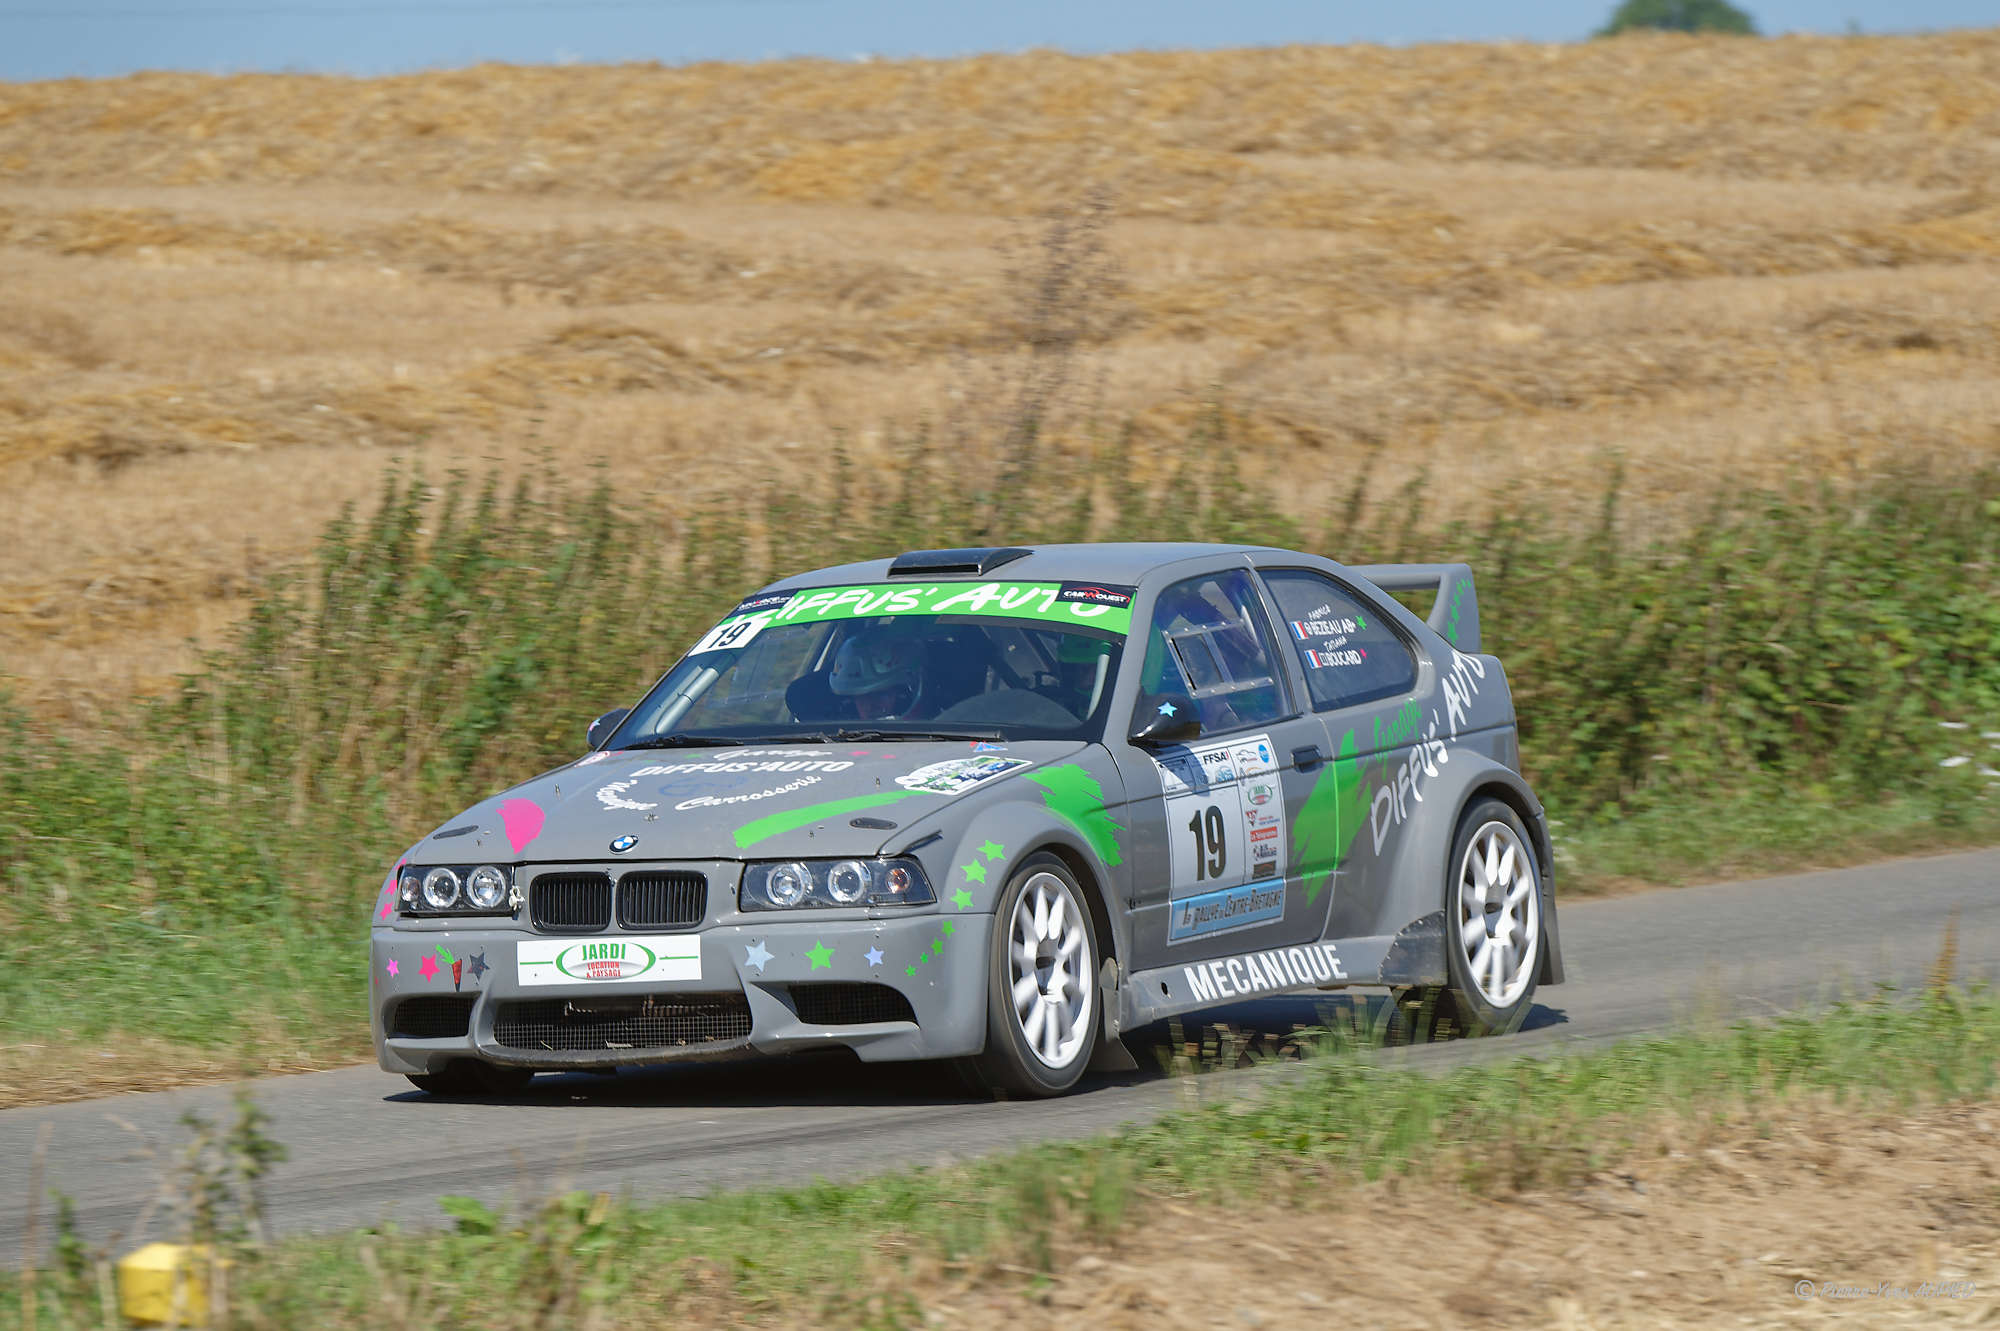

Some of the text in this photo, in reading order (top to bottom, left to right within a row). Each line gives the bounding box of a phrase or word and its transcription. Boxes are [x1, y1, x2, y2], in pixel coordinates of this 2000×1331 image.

[708, 621, 752, 649] 19
[1441, 650, 1486, 742] AUTO
[630, 761, 854, 777] DIFFUS'AUTO
[675, 775, 822, 811] Carrosserie
[1189, 805, 1226, 881] 19
[582, 943, 626, 961] JARDI
[587, 961, 620, 970] LOCATION
[592, 969, 621, 978] PAYSAGE
[1183, 944, 1348, 1002] MECANIQUE
